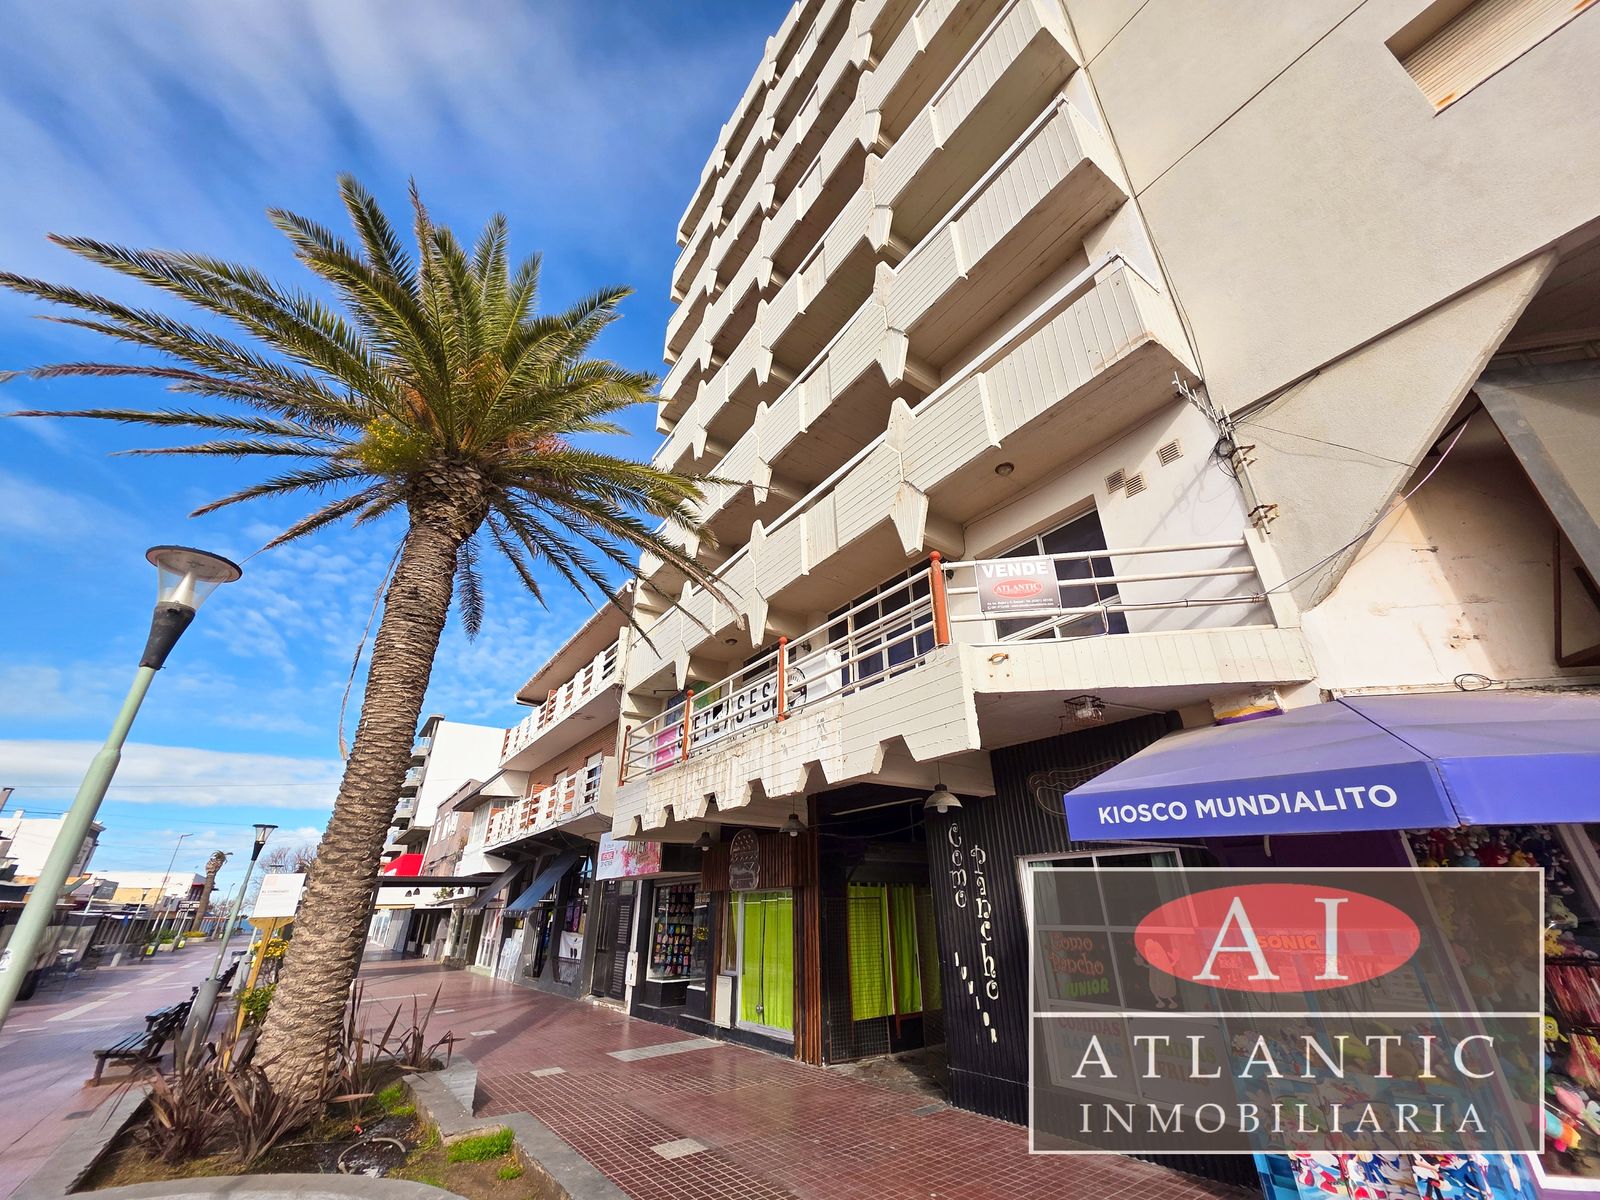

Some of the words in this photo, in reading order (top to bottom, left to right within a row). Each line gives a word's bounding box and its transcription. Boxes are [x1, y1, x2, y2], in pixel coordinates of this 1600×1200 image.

[981, 561, 1049, 578] VENDE
[996, 582, 1040, 593] ATLANTIC
[1098, 800, 1188, 825] KIOSCO
[1195, 784, 1398, 819] MUNDIALITO
[1256, 934, 1320, 951] SONIC
